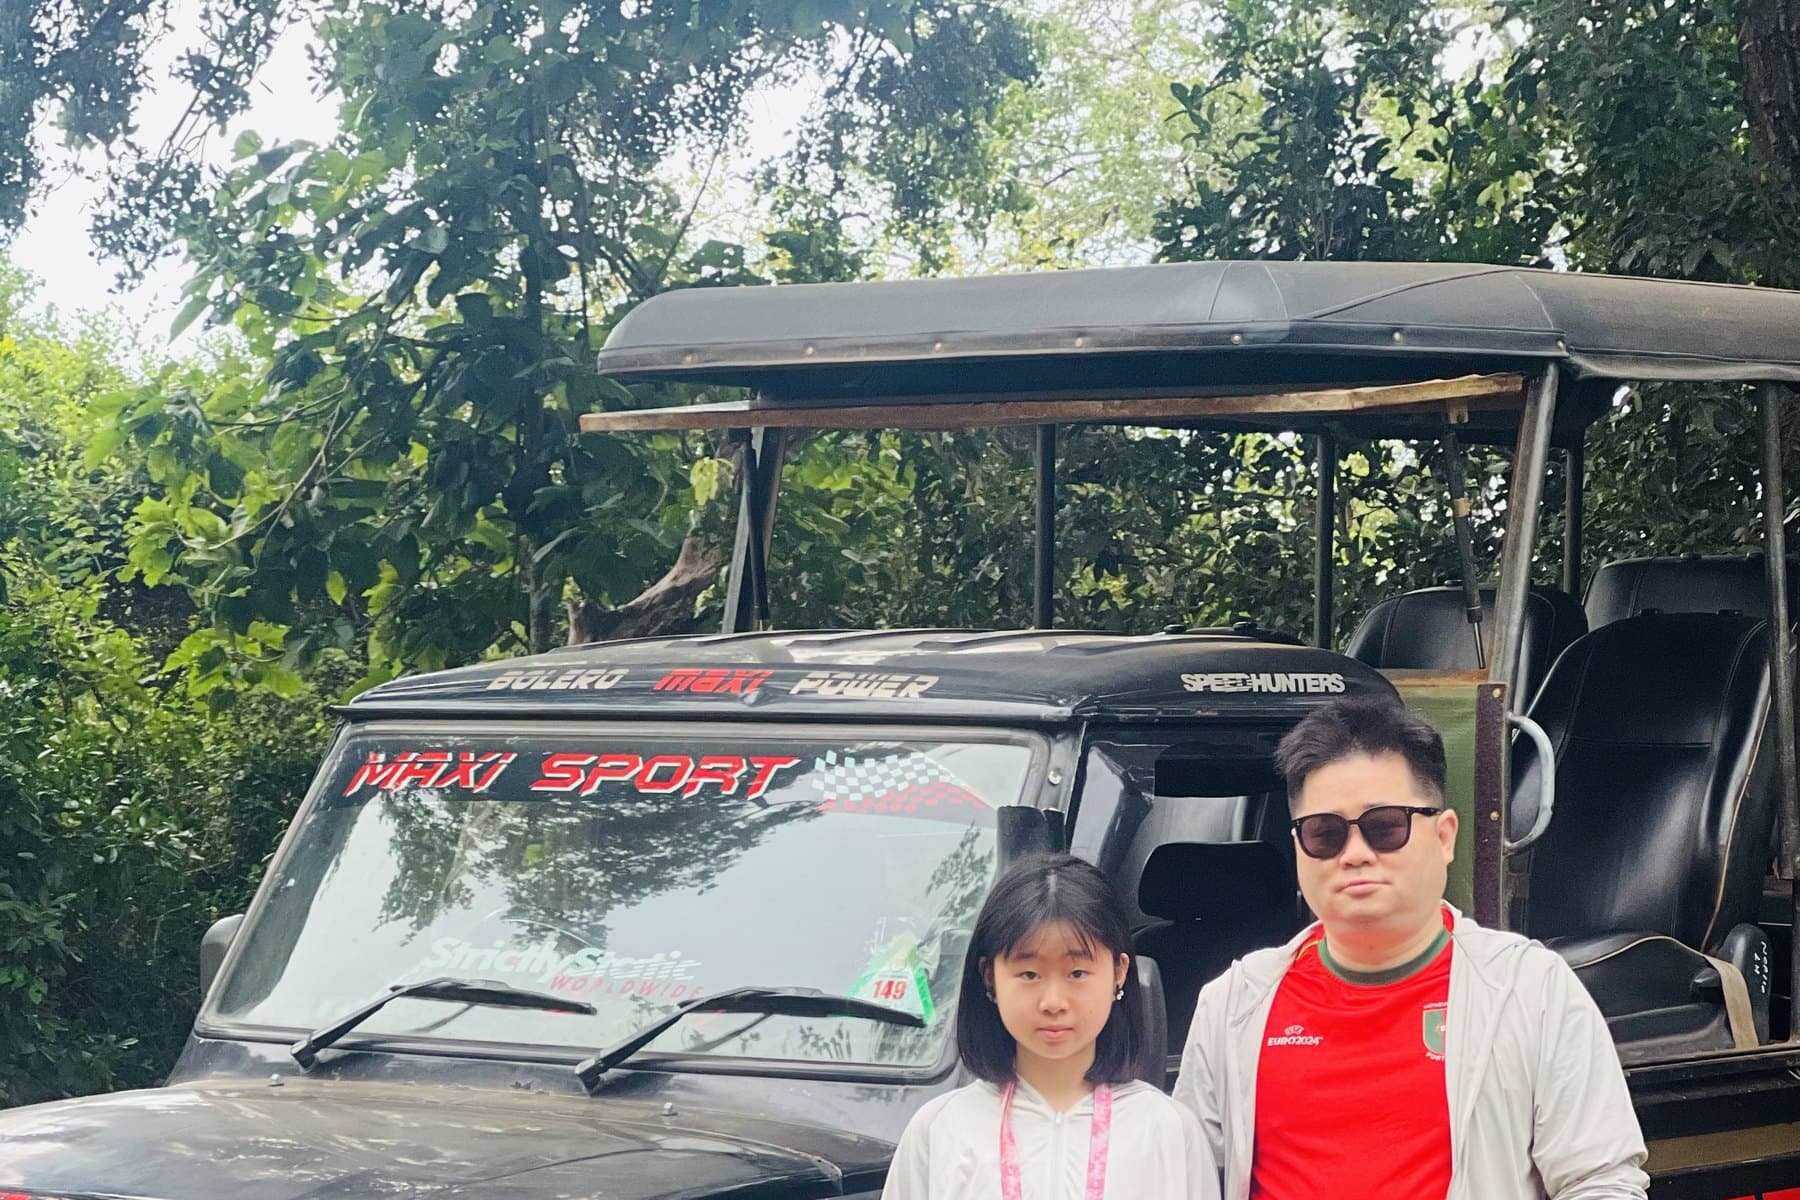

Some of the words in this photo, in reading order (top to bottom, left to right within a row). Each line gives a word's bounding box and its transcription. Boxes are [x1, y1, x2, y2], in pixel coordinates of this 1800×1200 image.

[486, 668, 630, 690] BOLERO
[789, 671, 940, 699] POWER
[1180, 673, 1346, 693] SPEEDHUNTERS
[343, 752, 517, 798] MAXI
[530, 753, 801, 800] SPORT
[873, 980, 907, 1000] 149
[1267, 1036, 1320, 1047] EURO2024
